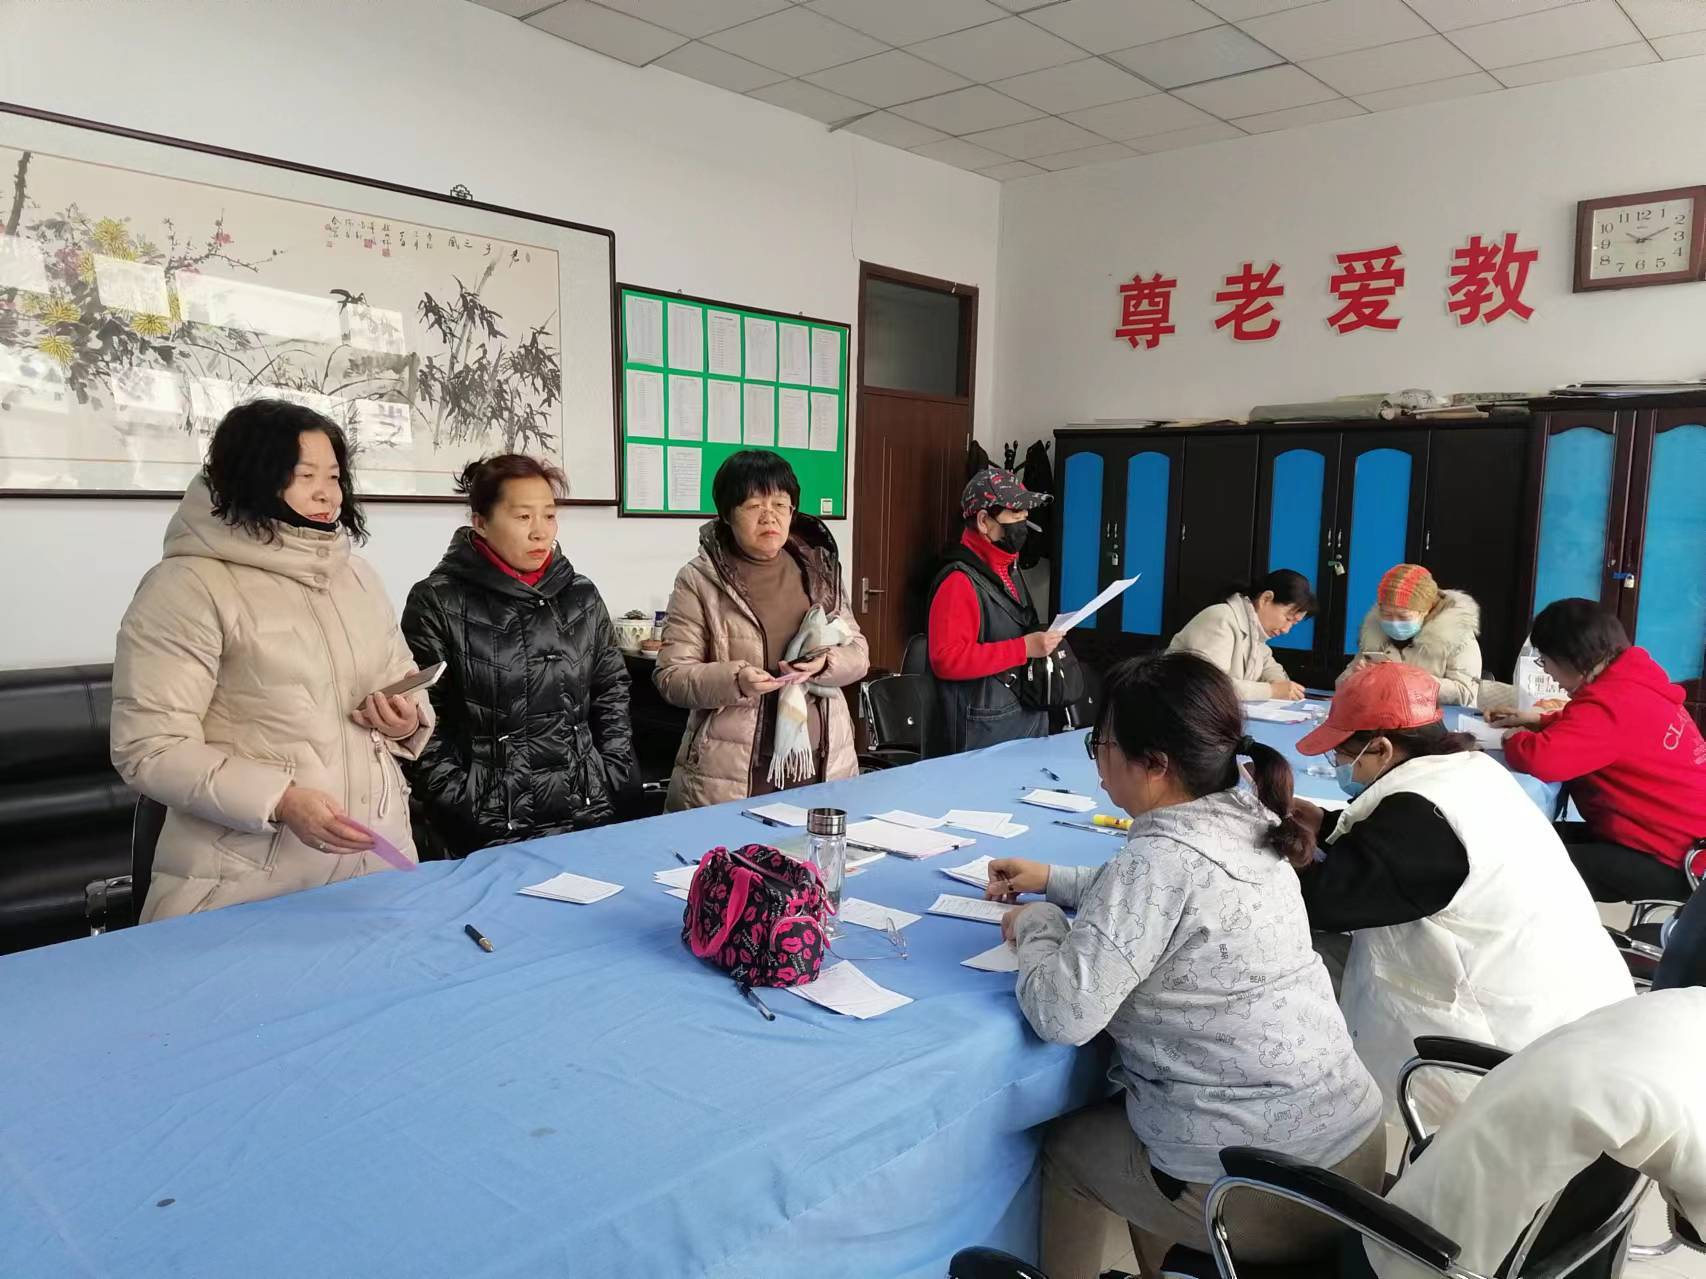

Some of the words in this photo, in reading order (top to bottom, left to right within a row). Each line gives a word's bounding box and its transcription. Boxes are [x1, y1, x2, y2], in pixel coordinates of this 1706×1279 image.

[1619, 212, 1630, 223] 11
[1637, 210, 1652, 221] 12
[1674, 214, 1686, 225] 2
[1601, 223, 1614, 234] 10
[1673, 231, 1685, 241] 3
[1600, 239, 1611, 250] 9
[1672, 247, 1682, 257] 4
[1600, 255, 1611, 266] 8
[1635, 260, 1646, 270] 6
[1655, 257, 1666, 268] 5
[1616, 262, 1625, 272] 7
[1114, 232, 1539, 350] 尊老爱教
[1249, 975, 1266, 984] BEAR
